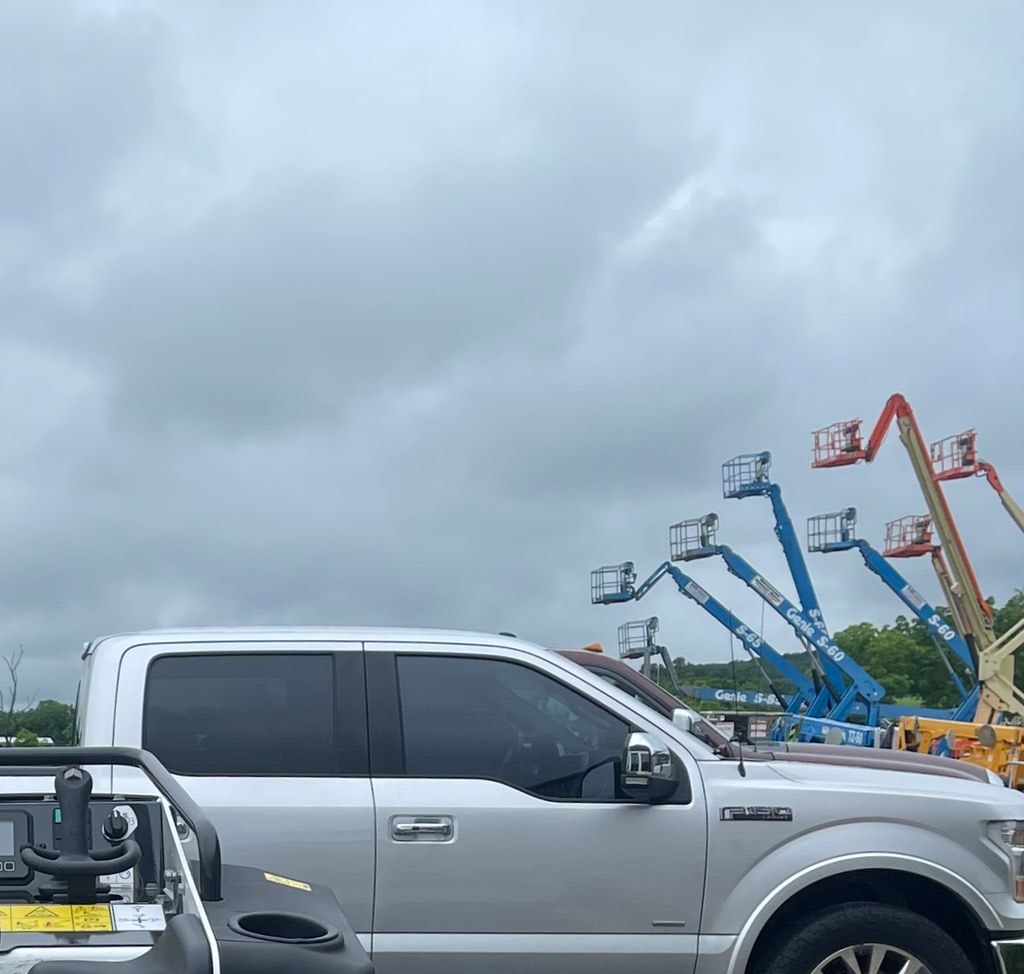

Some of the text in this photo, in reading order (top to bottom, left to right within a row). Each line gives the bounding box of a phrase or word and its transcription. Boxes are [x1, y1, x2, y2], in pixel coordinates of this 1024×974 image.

[736, 625, 762, 648] S-65
[787, 608, 845, 661] Genie S-60
[928, 614, 956, 640] S-60
[715, 689, 747, 702] Genie
